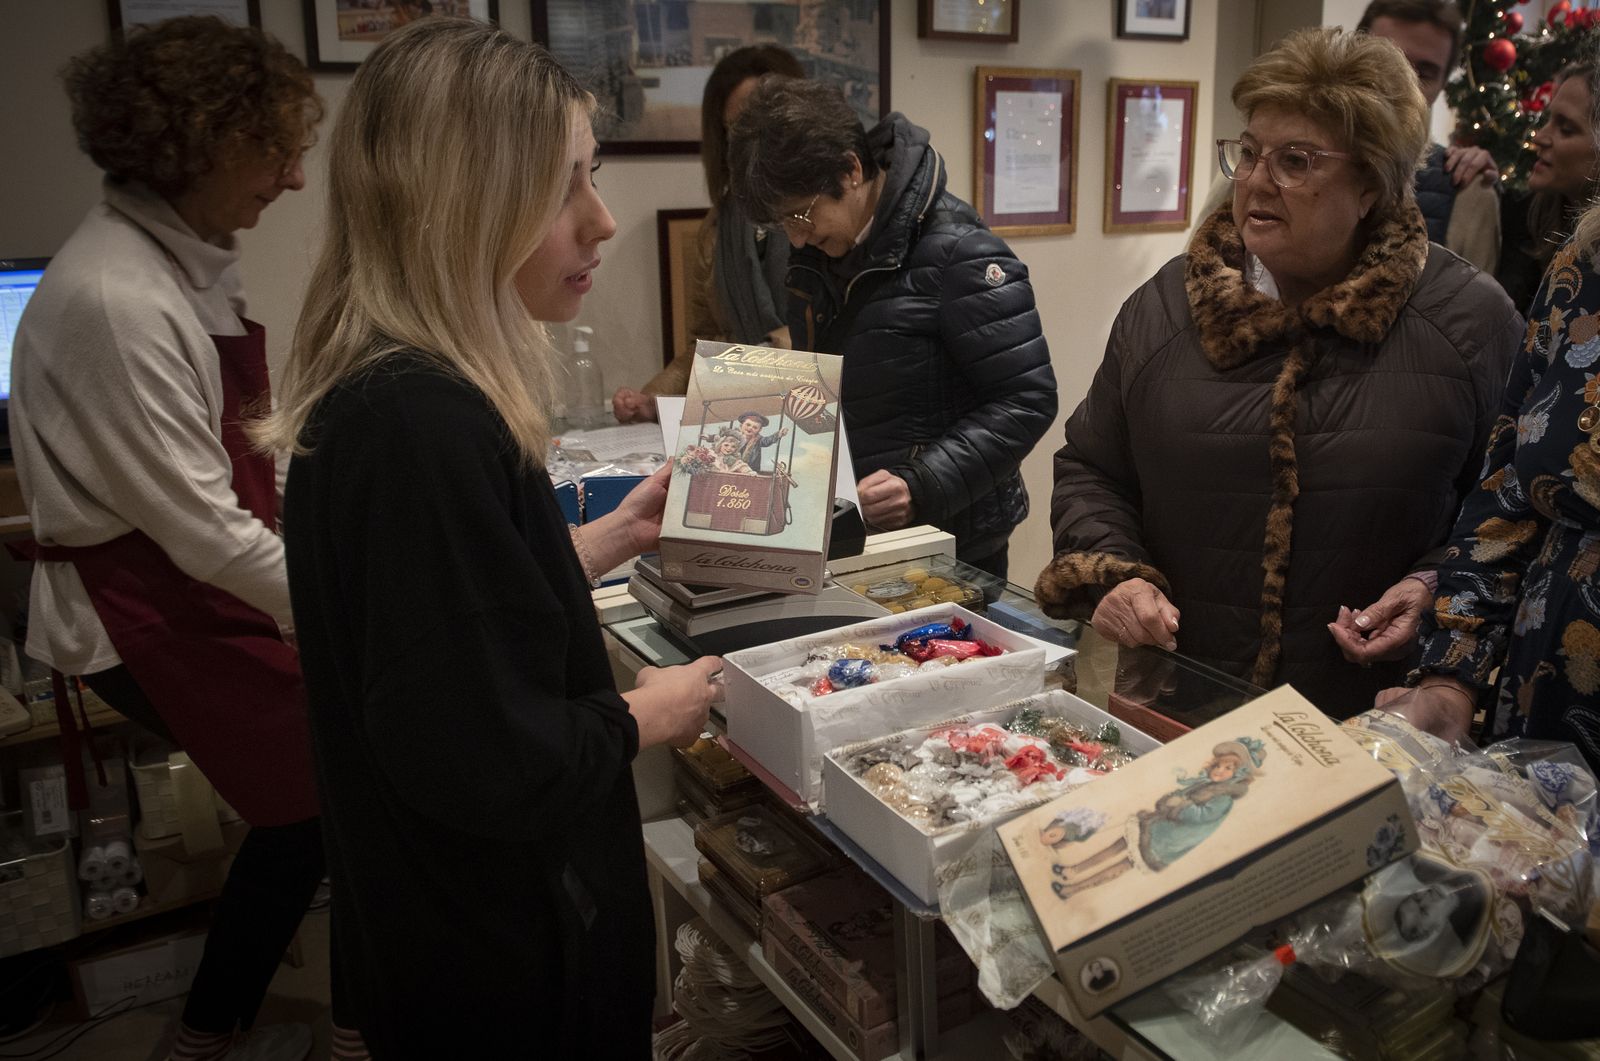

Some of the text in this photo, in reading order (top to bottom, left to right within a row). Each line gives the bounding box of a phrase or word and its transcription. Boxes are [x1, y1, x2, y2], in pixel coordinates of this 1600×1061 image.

[712, 343, 818, 371] La Colchona
[719, 484, 750, 498] Desde
[717, 497, 751, 510] 1.850
[685, 552, 799, 574] La Colchona
[1273, 711, 1308, 724] La
[1290, 721, 1341, 766] Colchona
